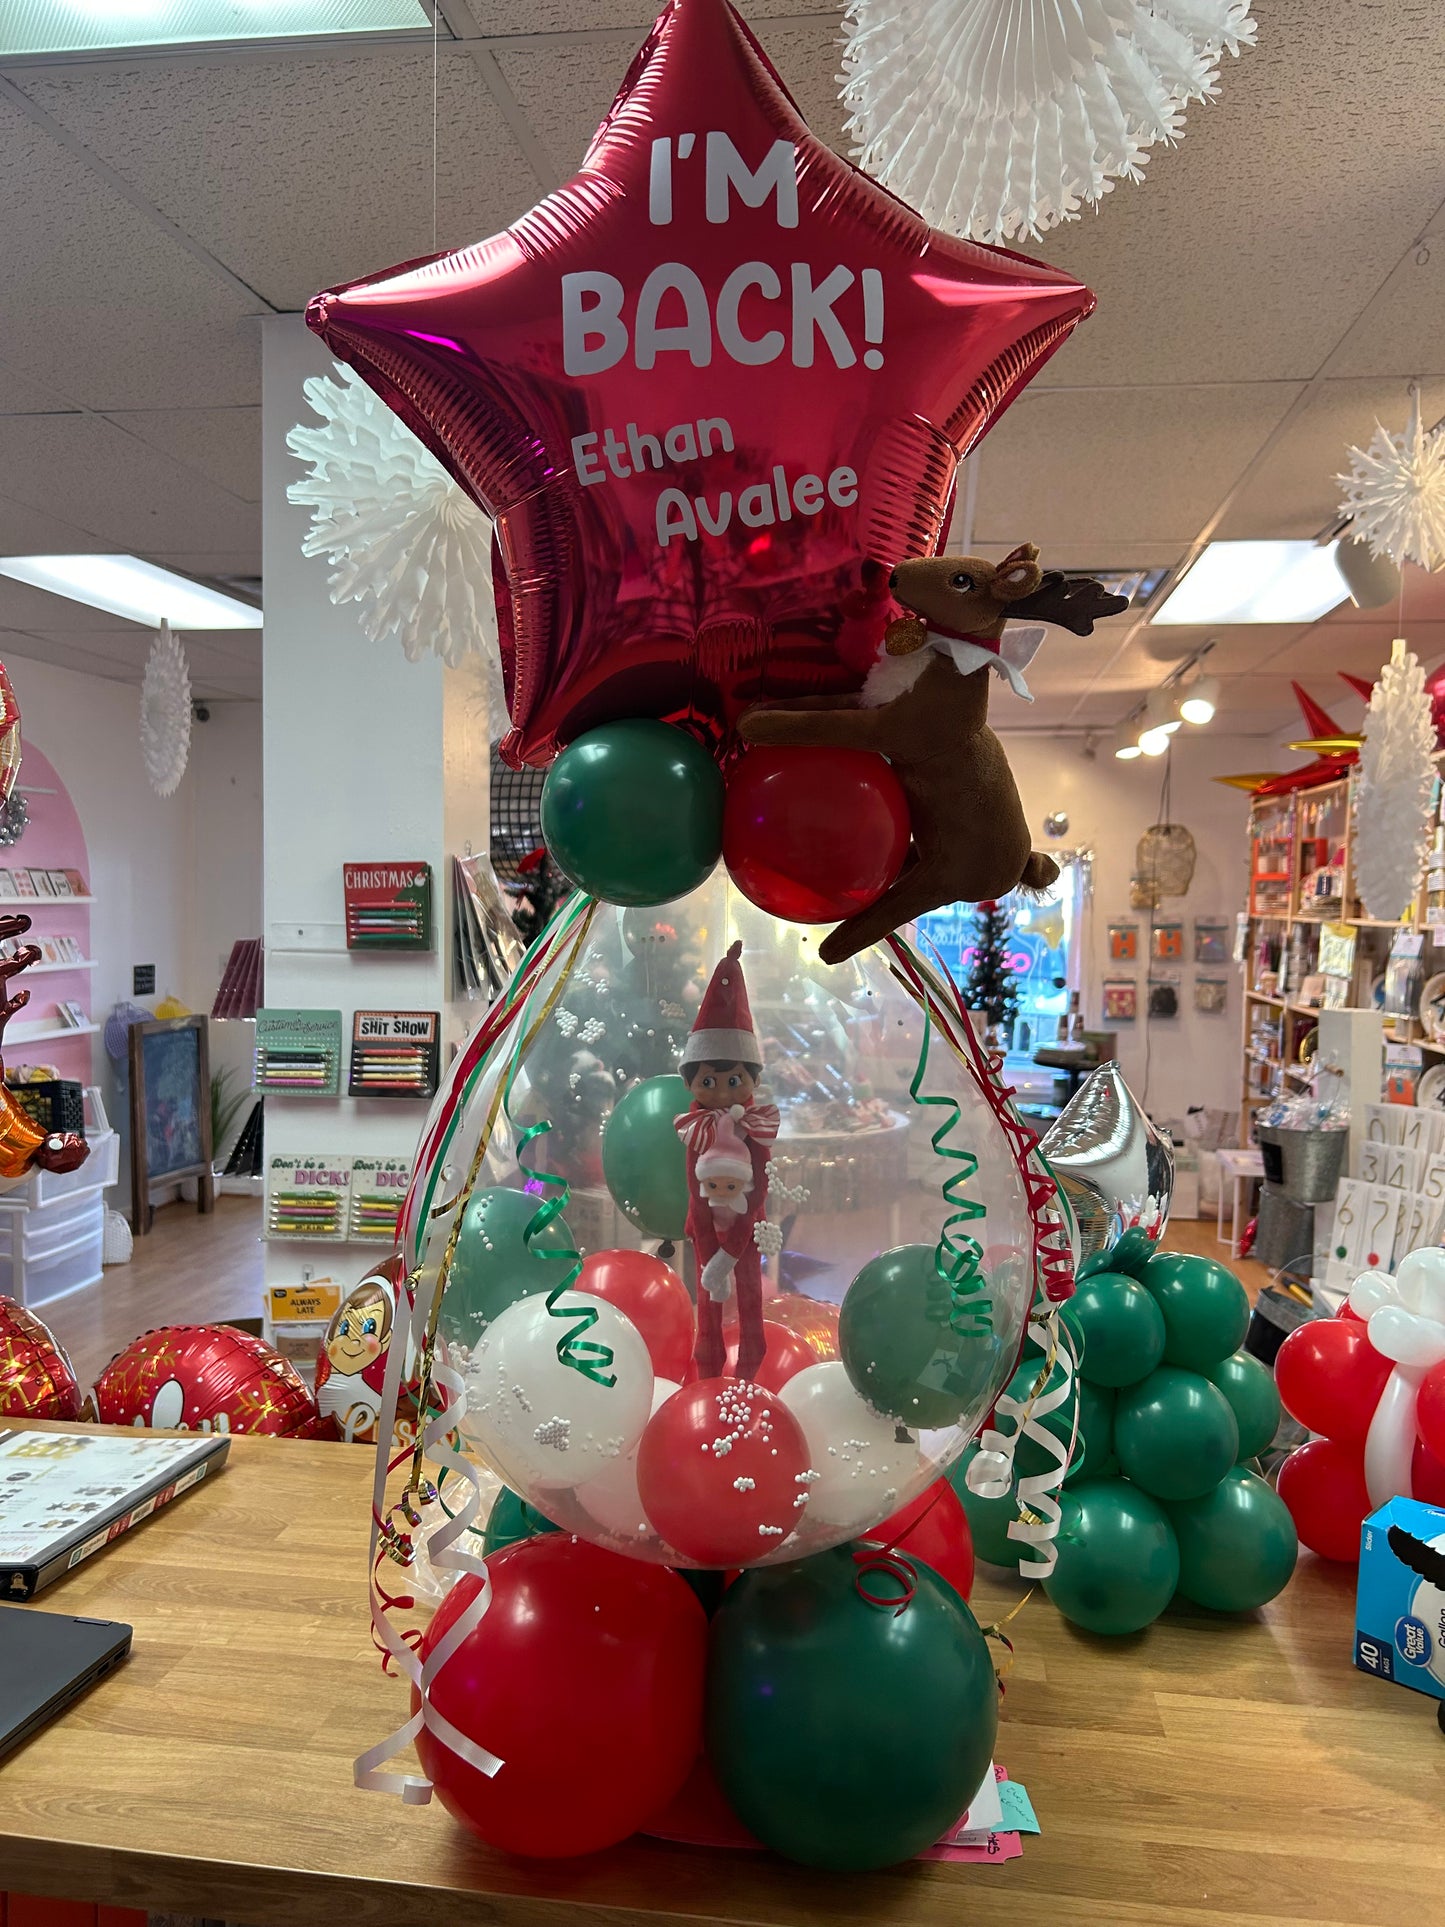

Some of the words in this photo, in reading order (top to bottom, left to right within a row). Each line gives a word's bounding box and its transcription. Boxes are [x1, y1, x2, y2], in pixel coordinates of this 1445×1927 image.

[649, 131, 799, 229] I'M
[561, 261, 885, 377] BACK!
[571, 417, 735, 486] Ethan
[655, 465, 858, 547] Avalee
[345, 870, 413, 889] CHRISTMAS
[393, 1020, 430, 1036] SHOW
[271, 1158, 301, 1169] Don't
[304, 1159, 315, 1169] be
[353, 1160, 383, 1171] Don't
[294, 1170, 350, 1186] DICK!
[376, 1171, 410, 1188] DIC
[290, 1298, 321, 1306] ALWAYS
[297, 1306, 315, 1314] LATE
[1365, 1530, 1373, 1551] Slider
[1404, 1623, 1417, 1659] Great
[1415, 1627, 1425, 1655] Value
[1360, 1641, 1379, 1669] 40
[1383, 1657, 1391, 1674] BAGS
